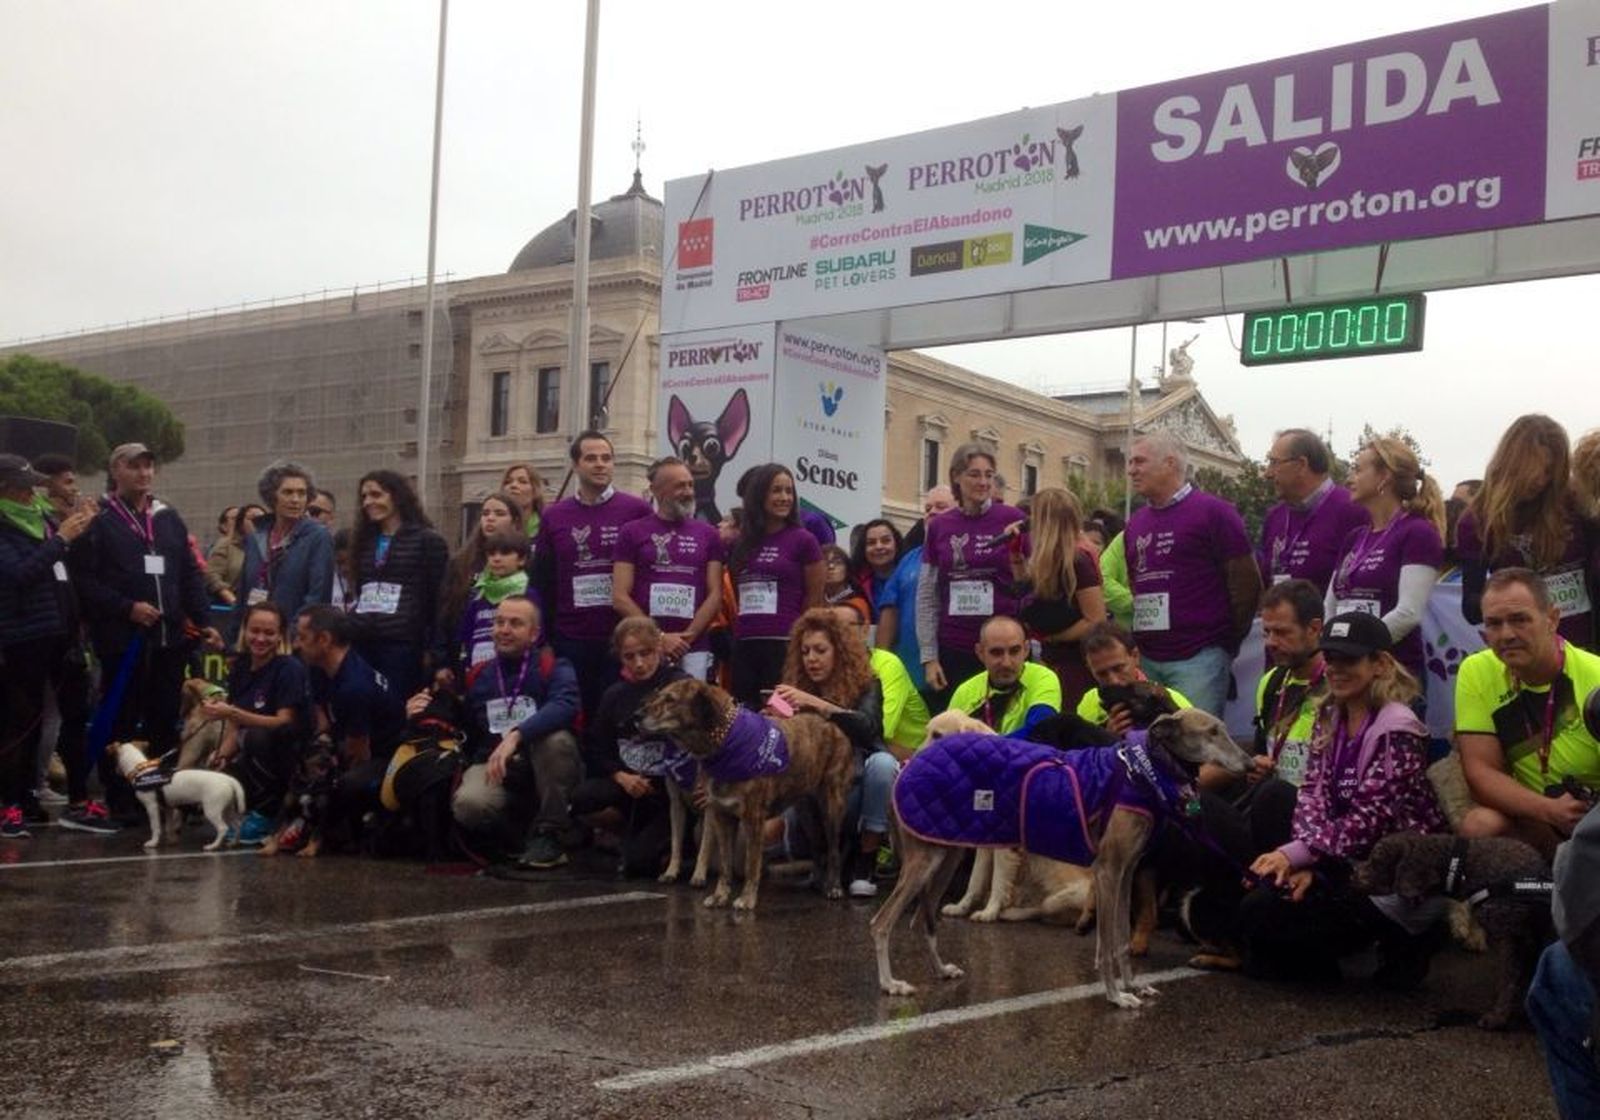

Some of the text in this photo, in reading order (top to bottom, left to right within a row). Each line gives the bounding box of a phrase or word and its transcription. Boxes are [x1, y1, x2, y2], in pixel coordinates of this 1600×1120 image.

[1150, 37, 1502, 164] SALIDA
[974, 168, 1055, 194] Madrid 2018
[795, 210, 835, 226] Madrid
[810, 206, 1013, 250] #CorreContraElAbandono
[1143, 174, 1503, 250] www.perroton.org
[737, 262, 809, 288] FRONTLINE
[814, 268, 897, 291] PET LOVERS
[815, 249, 896, 276] SUBARU
[1251, 302, 1407, 355] 00:00:00
[783, 332, 881, 374] www.perroton.org
[795, 455, 859, 491] Sense
